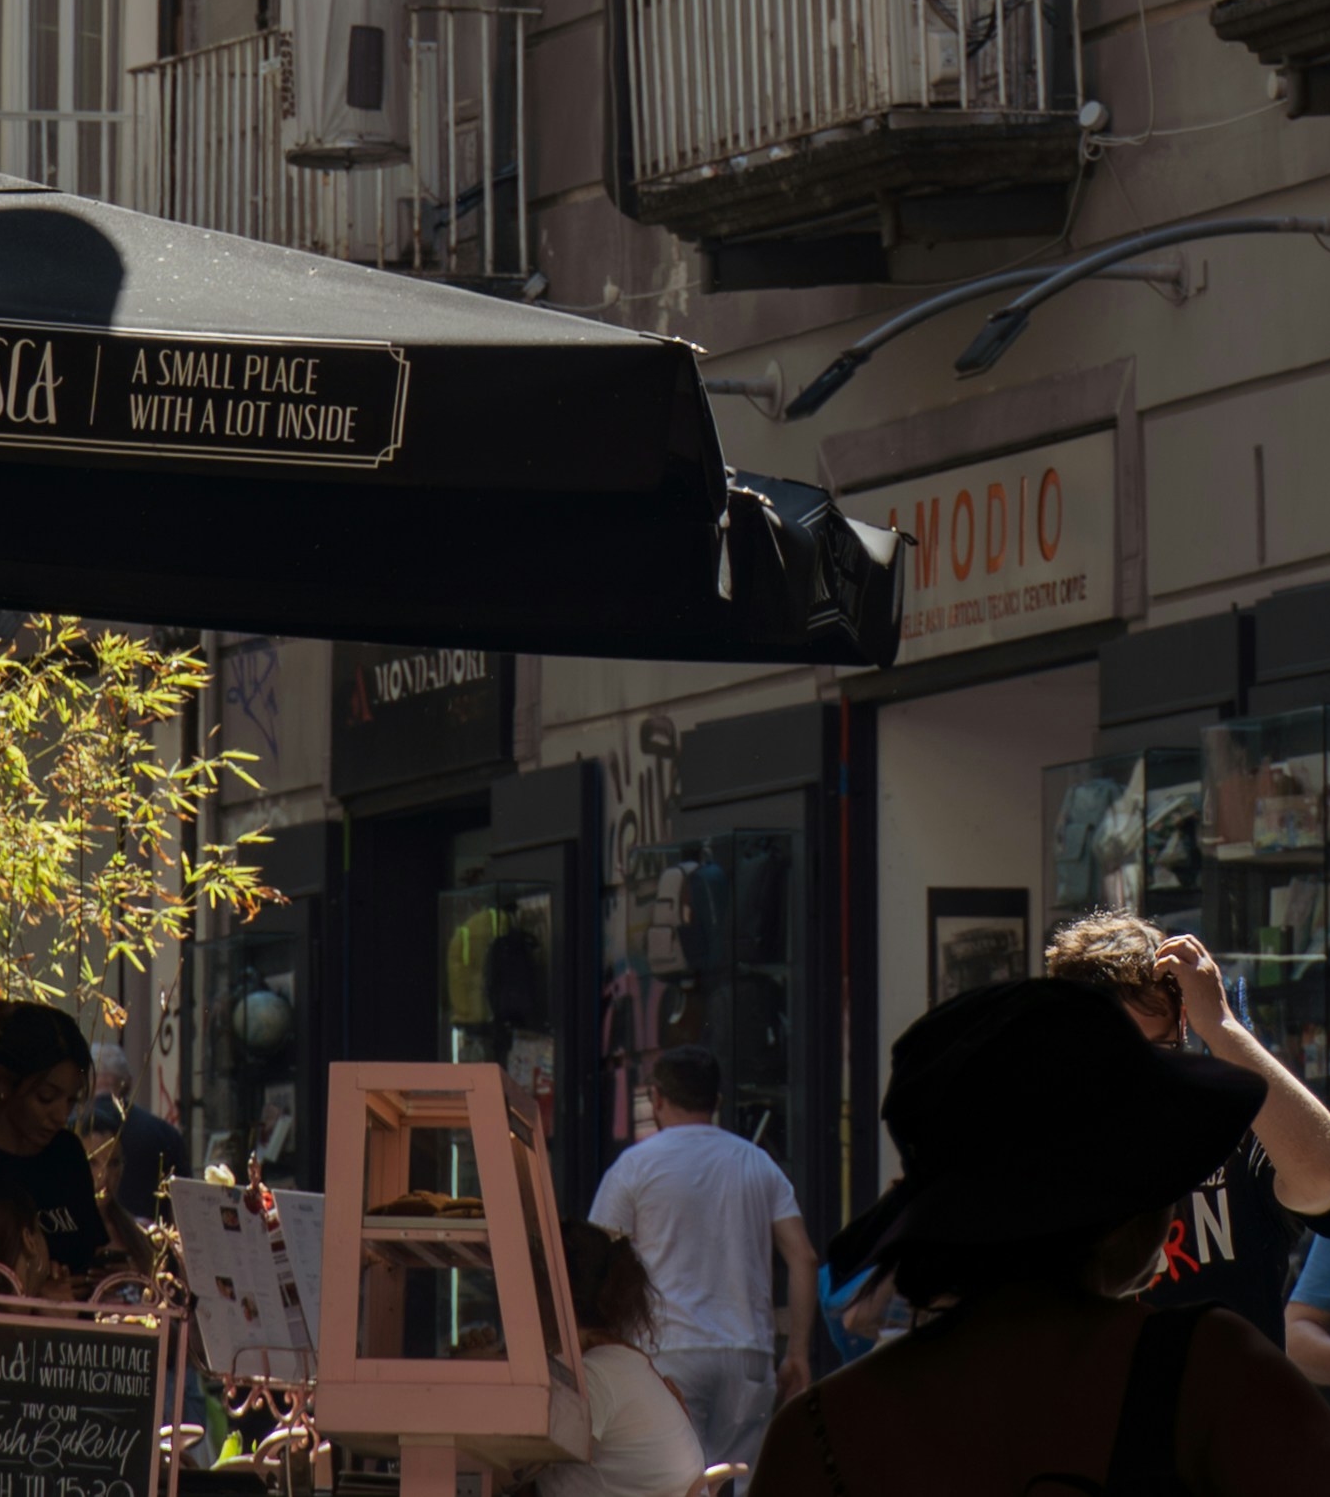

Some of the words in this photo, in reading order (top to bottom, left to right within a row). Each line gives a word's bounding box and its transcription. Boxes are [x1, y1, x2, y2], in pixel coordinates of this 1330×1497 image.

[132, 348, 148, 385] A
[156, 350, 235, 390] SMALL
[244, 354, 320, 396] PLACE
[130, 394, 192, 433] WITH
[199, 399, 216, 434] A
[225, 400, 271, 438] LOT
[277, 403, 359, 443] INSIDE
[888, 467, 1063, 592] MODIO
[373, 648, 487, 705] MONDADORI
[43, 1341, 54, 1363] A
[59, 1343, 109, 1368] SMALL
[112, 1345, 152, 1374] PLACE
[39, 1367, 75, 1389] WITH
[113, 1373, 150, 1397] INSIDE
[21, 1402, 45, 1420] TRY
[48, 1404, 78, 1422] OUR
